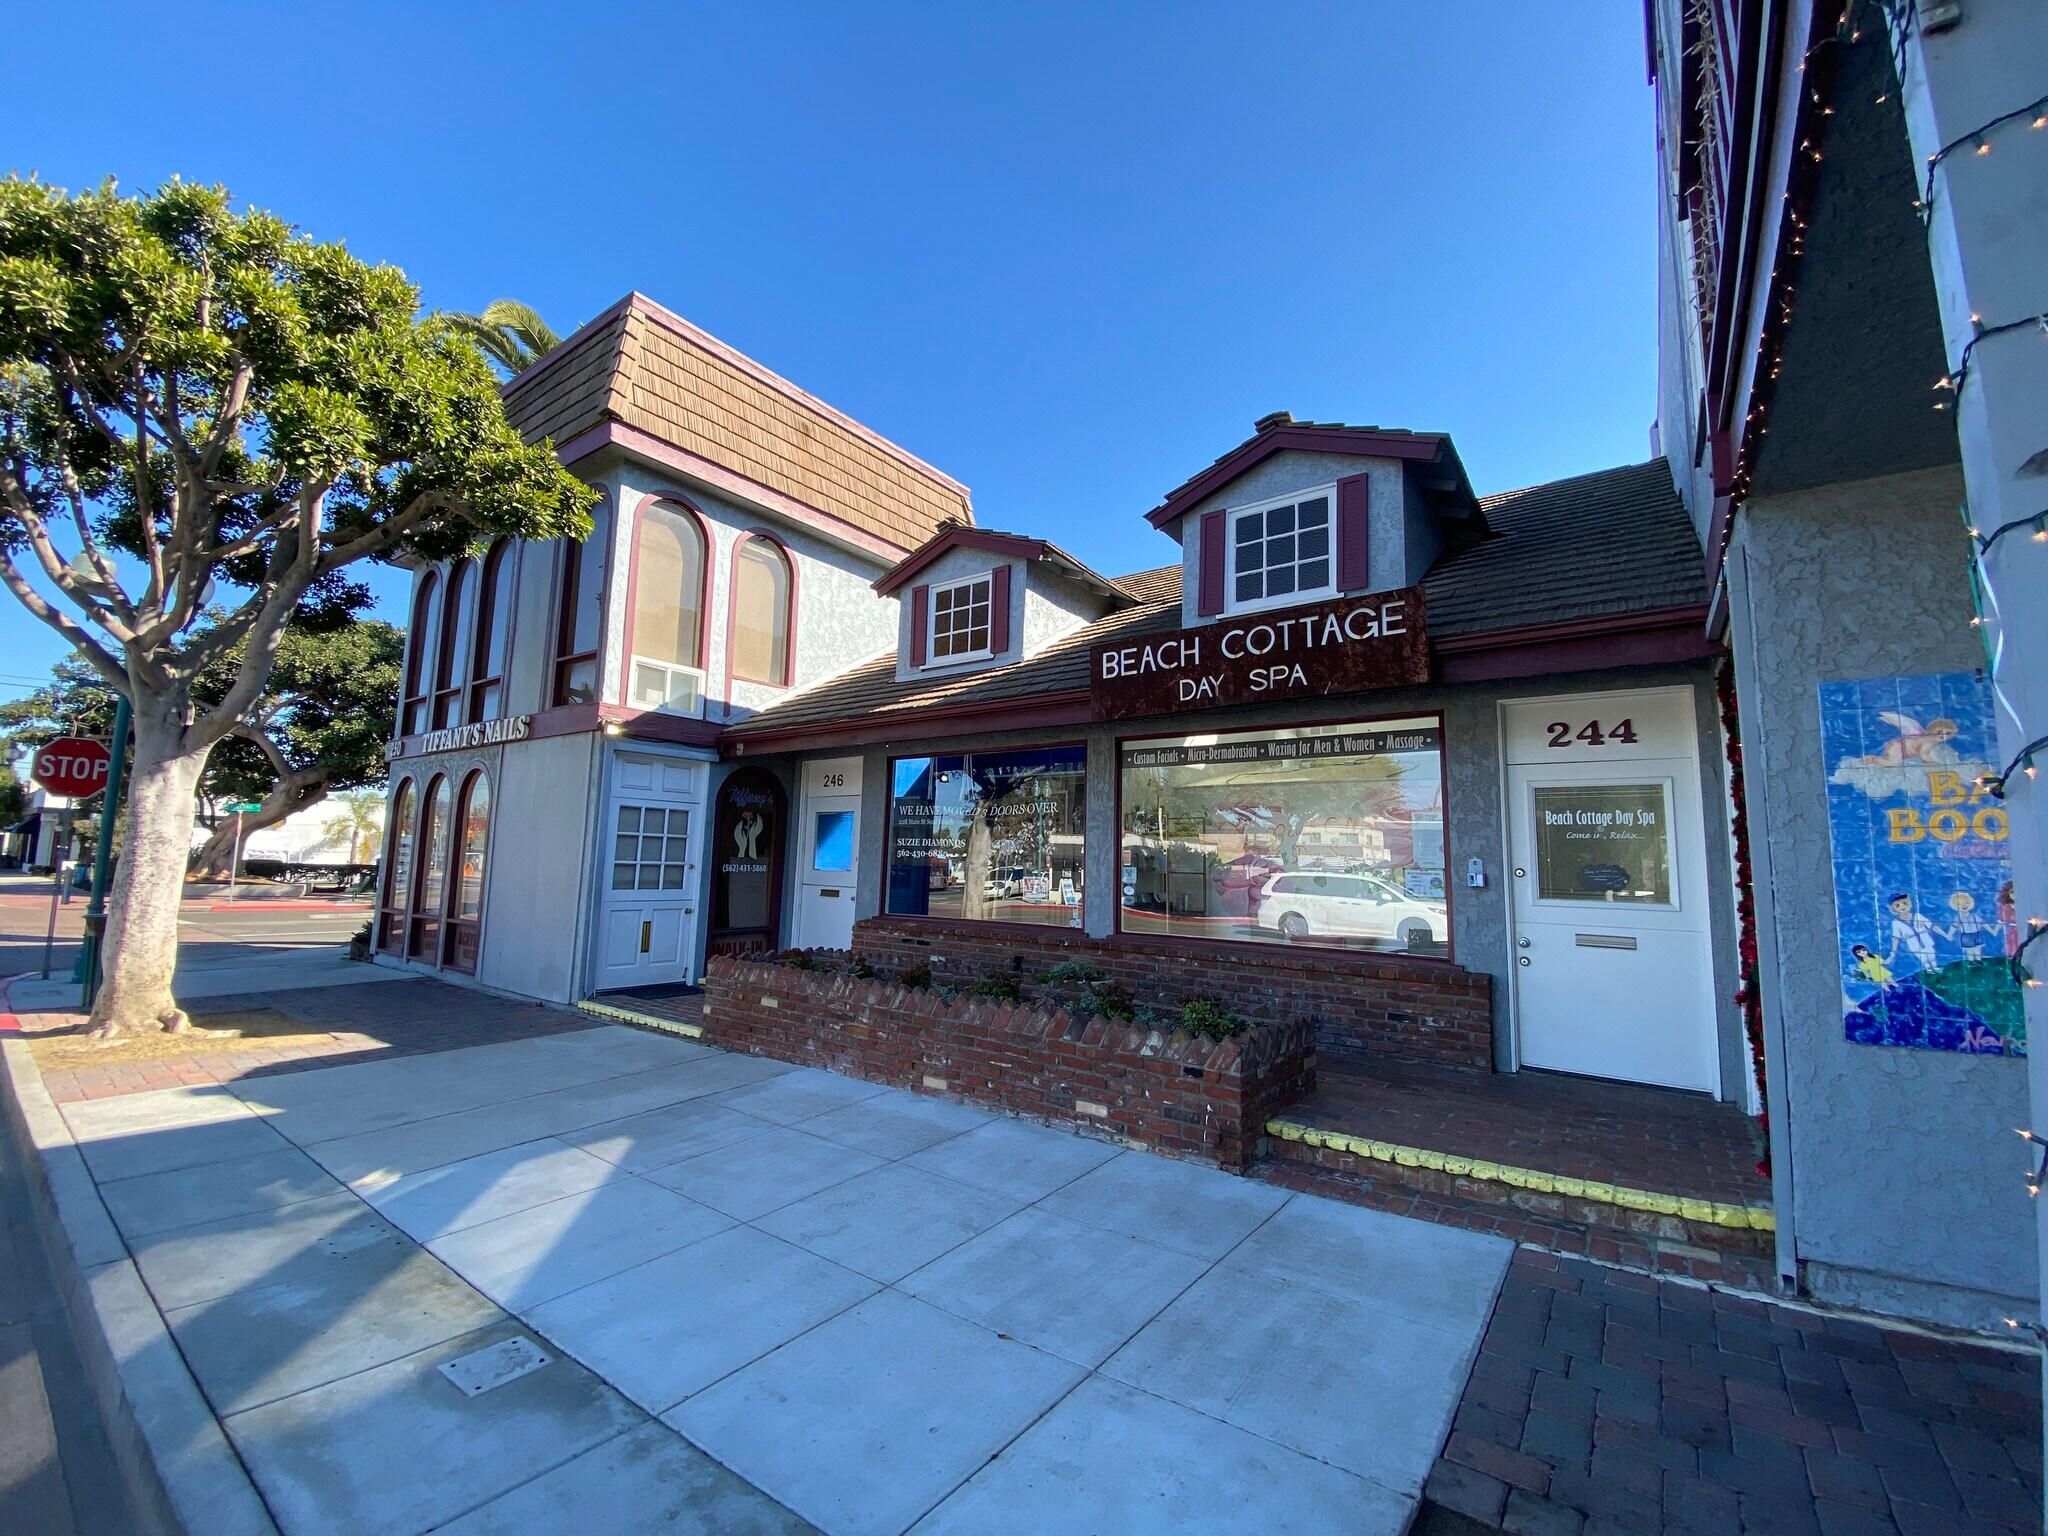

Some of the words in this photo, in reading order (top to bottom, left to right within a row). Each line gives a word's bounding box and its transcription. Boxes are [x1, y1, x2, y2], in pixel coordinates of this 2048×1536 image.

[1103, 636, 1200, 679] BEACH
[1221, 600, 1407, 660] COTTAGE
[1179, 674, 1224, 702] DAY
[1249, 663, 1307, 692] SPA
[422, 724, 482, 753] TIFFANY'S
[483, 715, 528, 744] NAILS
[1547, 719, 1638, 748] 244
[1133, 751, 1156, 765] Custom
[1157, 749, 1179, 764] Facials
[1187, 745, 1258, 762] Micro-Dermabrasion
[1267, 740, 1297, 757] Waxing
[1298, 740, 1311, 757] for
[1313, 739, 1331, 754] Men
[1333, 738, 1341, 752] &
[1343, 737, 1375, 752] Women
[1386, 734, 1424, 750] Massage
[38, 754, 110, 781] STOP
[823, 774, 844, 787] 246
[899, 805, 914, 816] WE
[915, 805, 941, 816] HAVE
[943, 805, 979, 816] MOVED
[980, 809, 988, 817] 3
[990, 804, 1026, 816] DOORS
[1027, 801, 1059, 815] OVER
[1545, 810, 1573, 826] Beach
[1576, 809, 1613, 827] Cottage
[1616, 809, 1634, 826] Day
[1637, 809, 1655, 826] Spa
[897, 838, 921, 846] SUZIE
[922, 838, 966, 847] DIAMONDS
[1566, 831, 1591, 840] Come
[723, 864, 739, 873] (562)
[712, 940, 763, 955] WALK-IN
